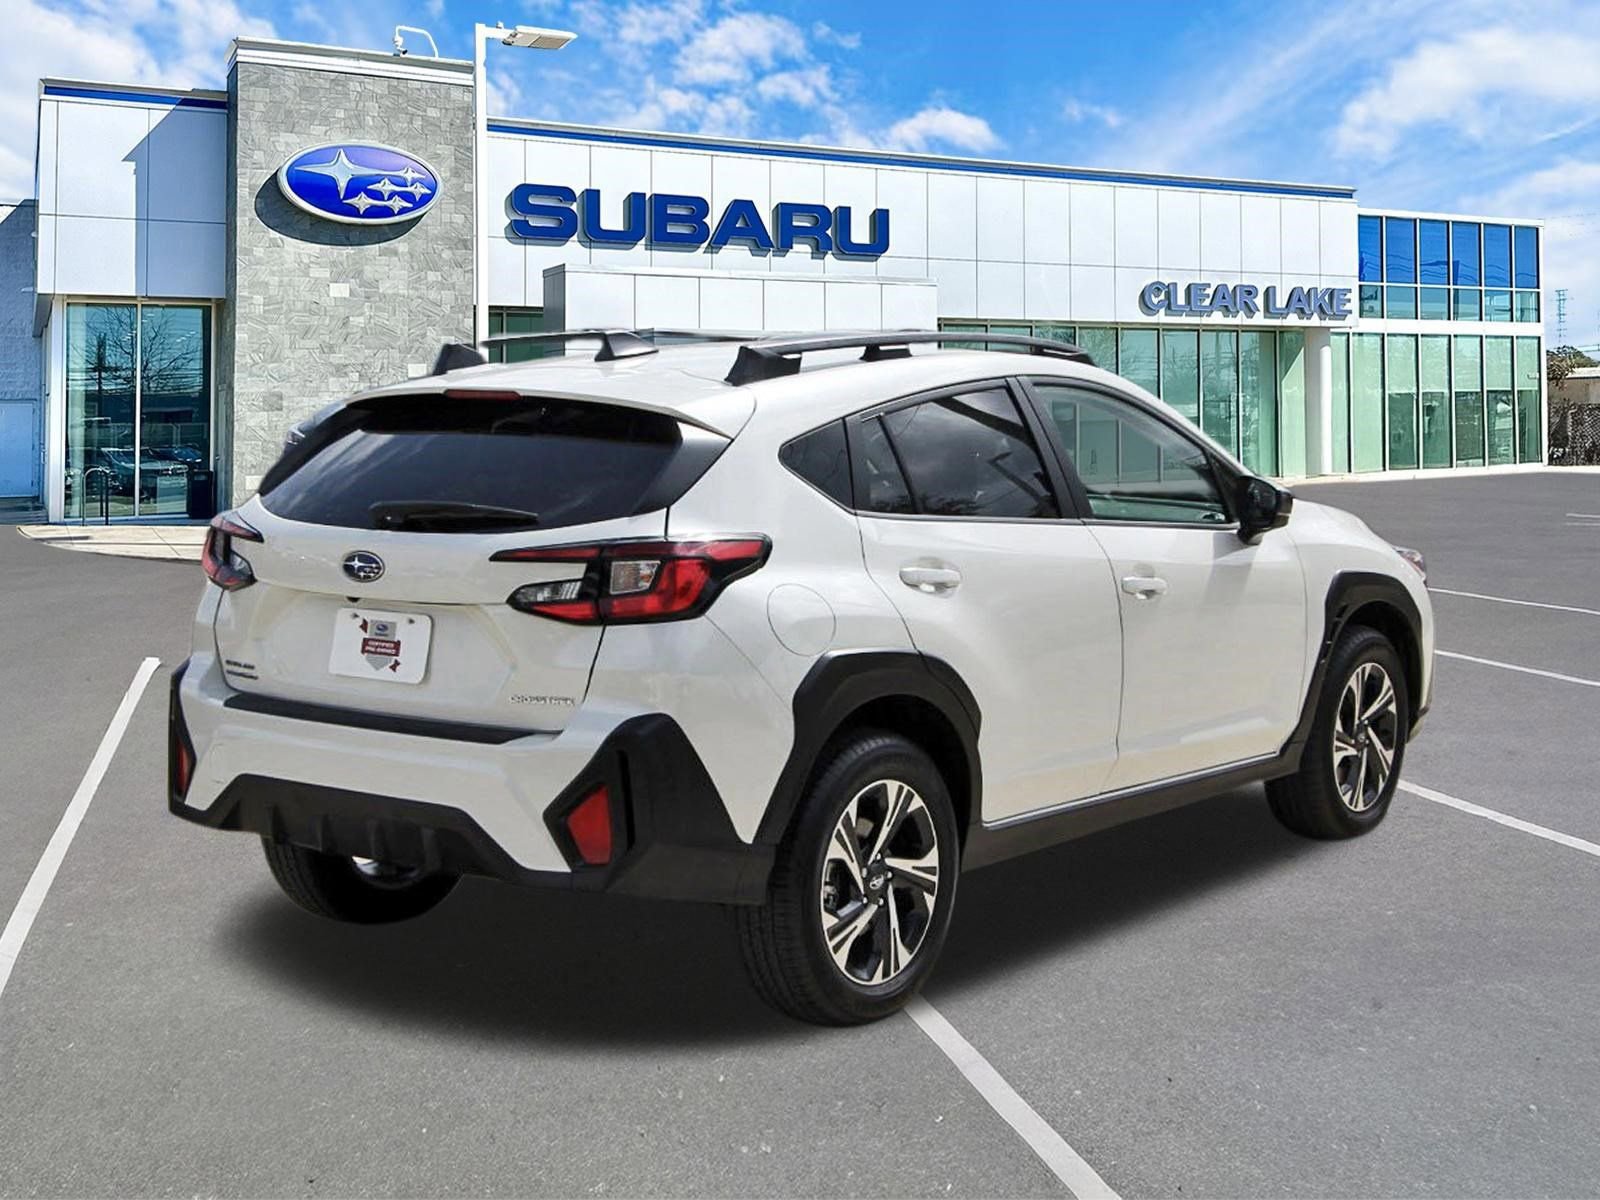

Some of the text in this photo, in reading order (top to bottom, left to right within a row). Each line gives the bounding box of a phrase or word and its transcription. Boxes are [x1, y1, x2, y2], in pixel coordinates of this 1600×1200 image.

[505, 183, 890, 261] SUBARU
[1139, 281, 1353, 320] CLEAR LAKE
